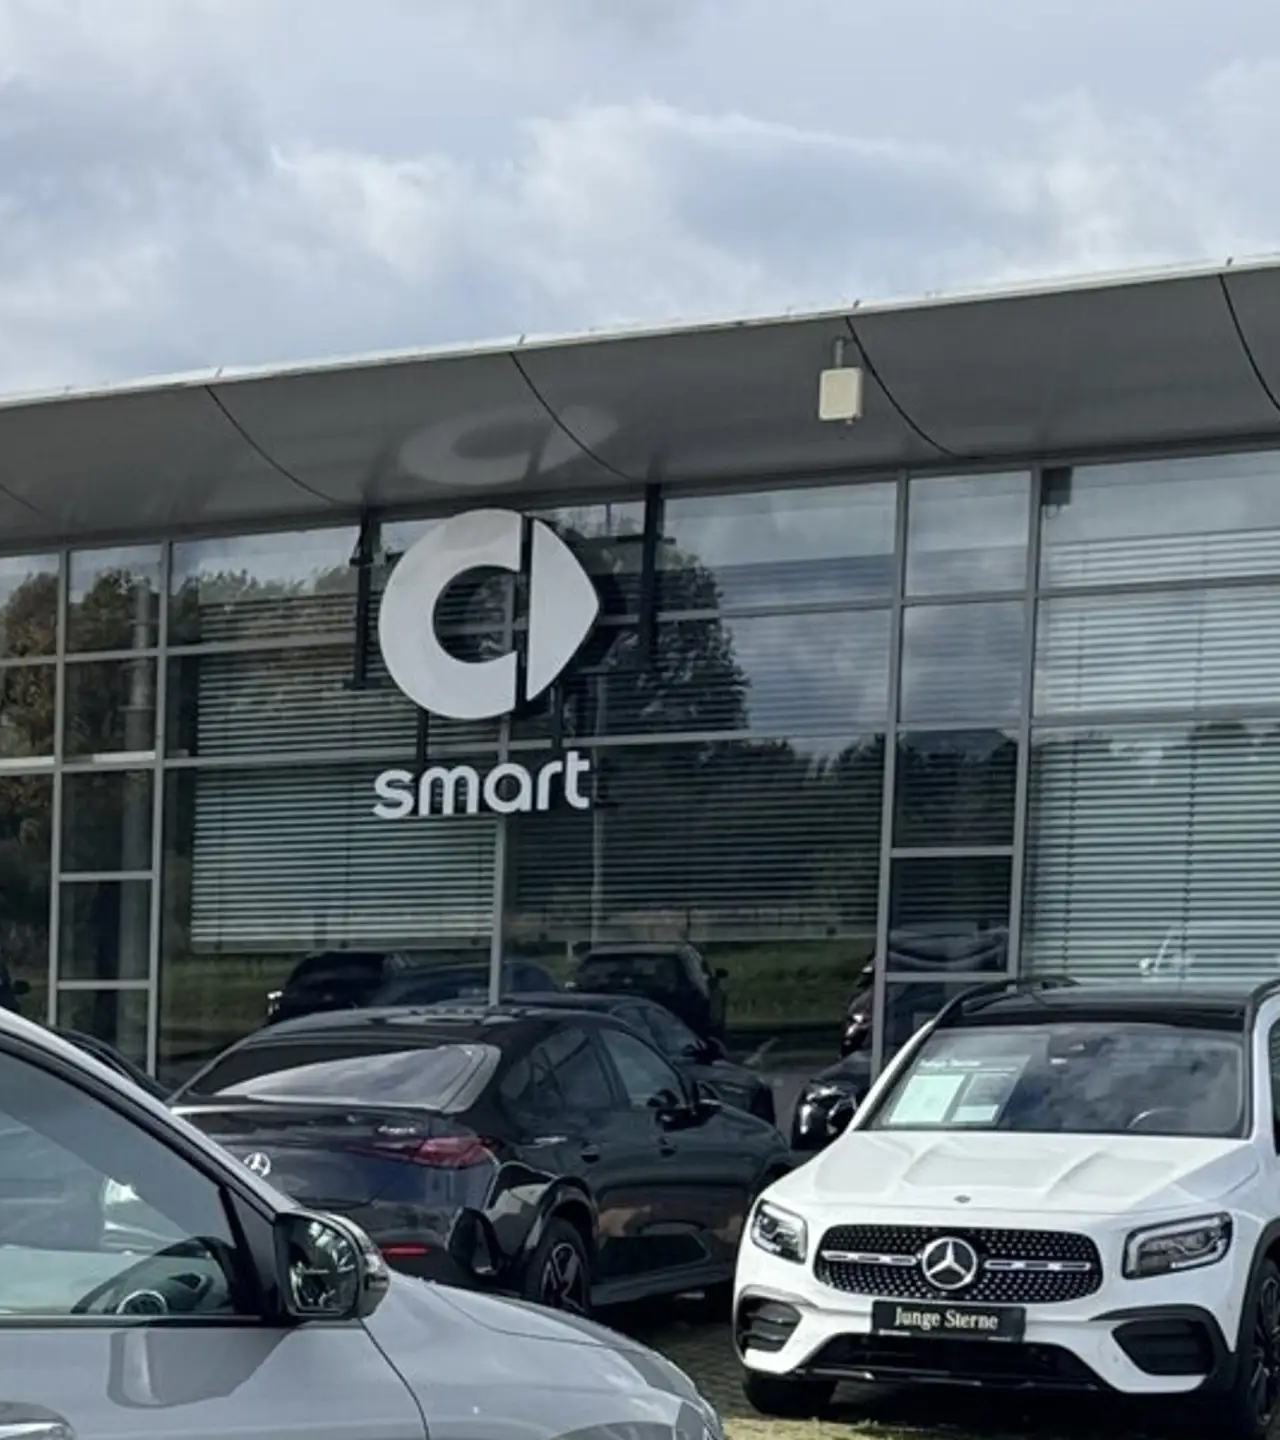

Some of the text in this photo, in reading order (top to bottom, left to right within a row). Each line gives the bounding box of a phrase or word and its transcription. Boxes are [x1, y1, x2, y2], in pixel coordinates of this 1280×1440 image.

[371, 750, 590, 820] smart
[893, 1306, 999, 1331] Junge Sterne
